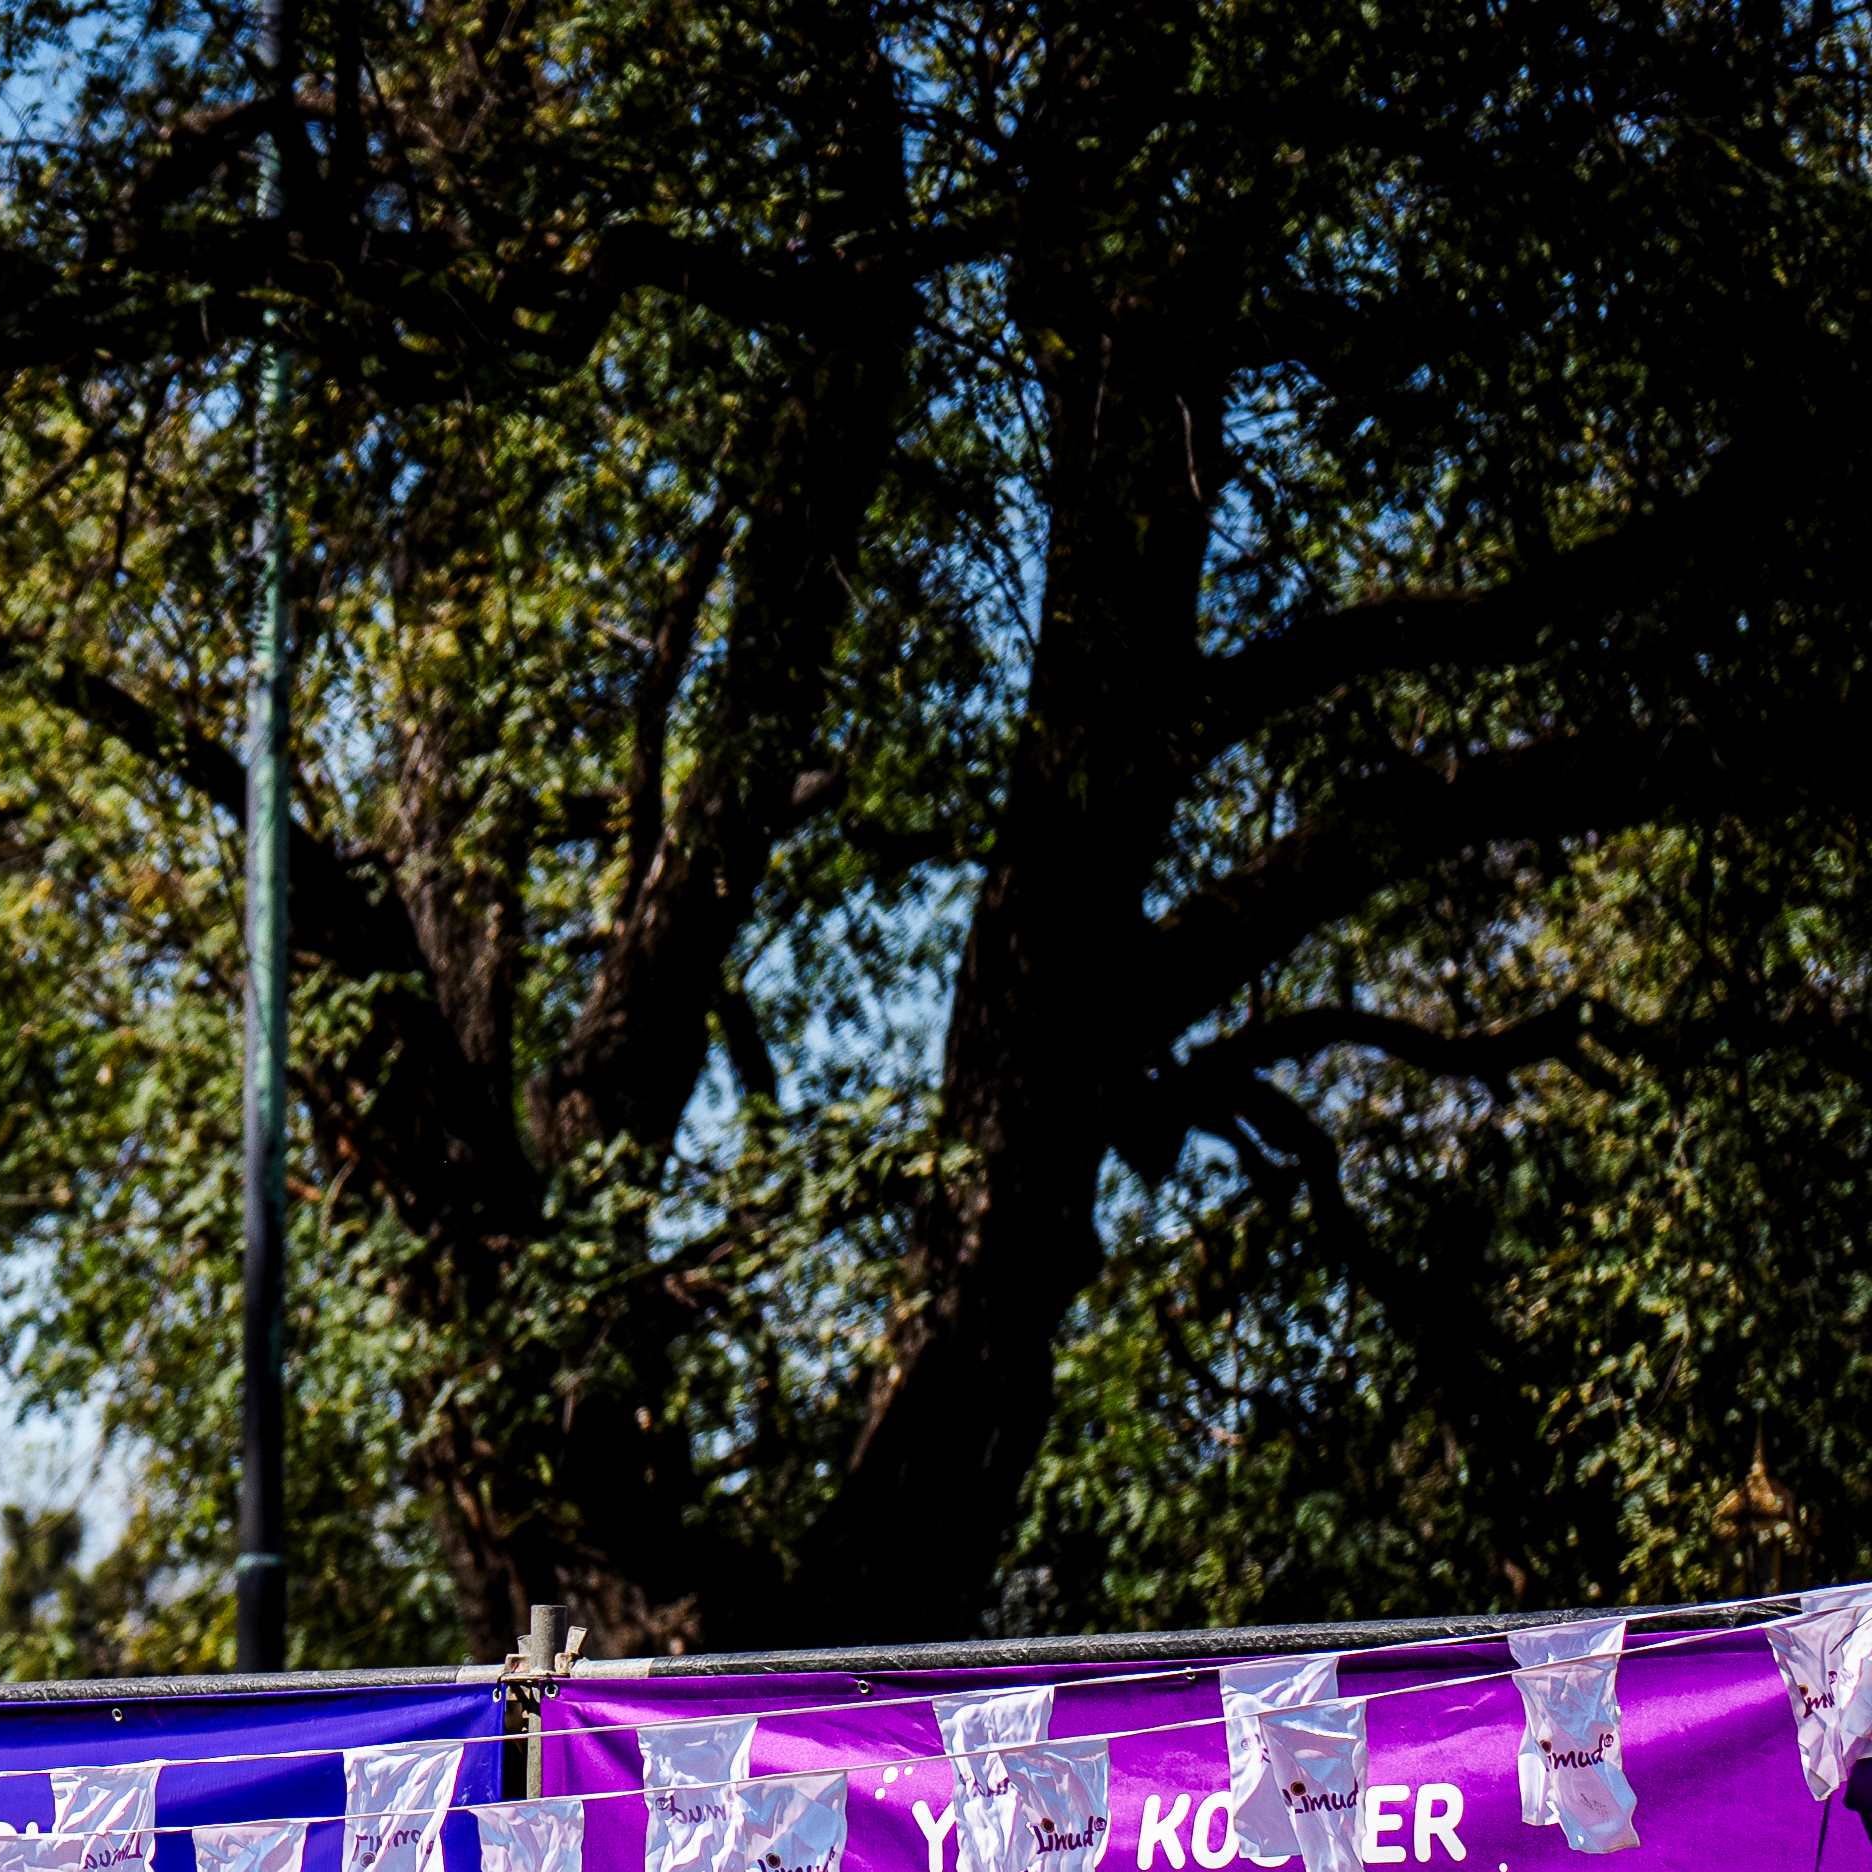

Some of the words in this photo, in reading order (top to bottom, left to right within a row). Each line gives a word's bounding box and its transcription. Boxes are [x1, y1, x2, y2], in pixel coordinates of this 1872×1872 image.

[1546, 1733, 1604, 1772] imud
[1282, 1778, 1359, 1814] Limud
[1032, 1816, 1094, 1854] Limud
[1136, 1782, 1468, 1872] KOER
